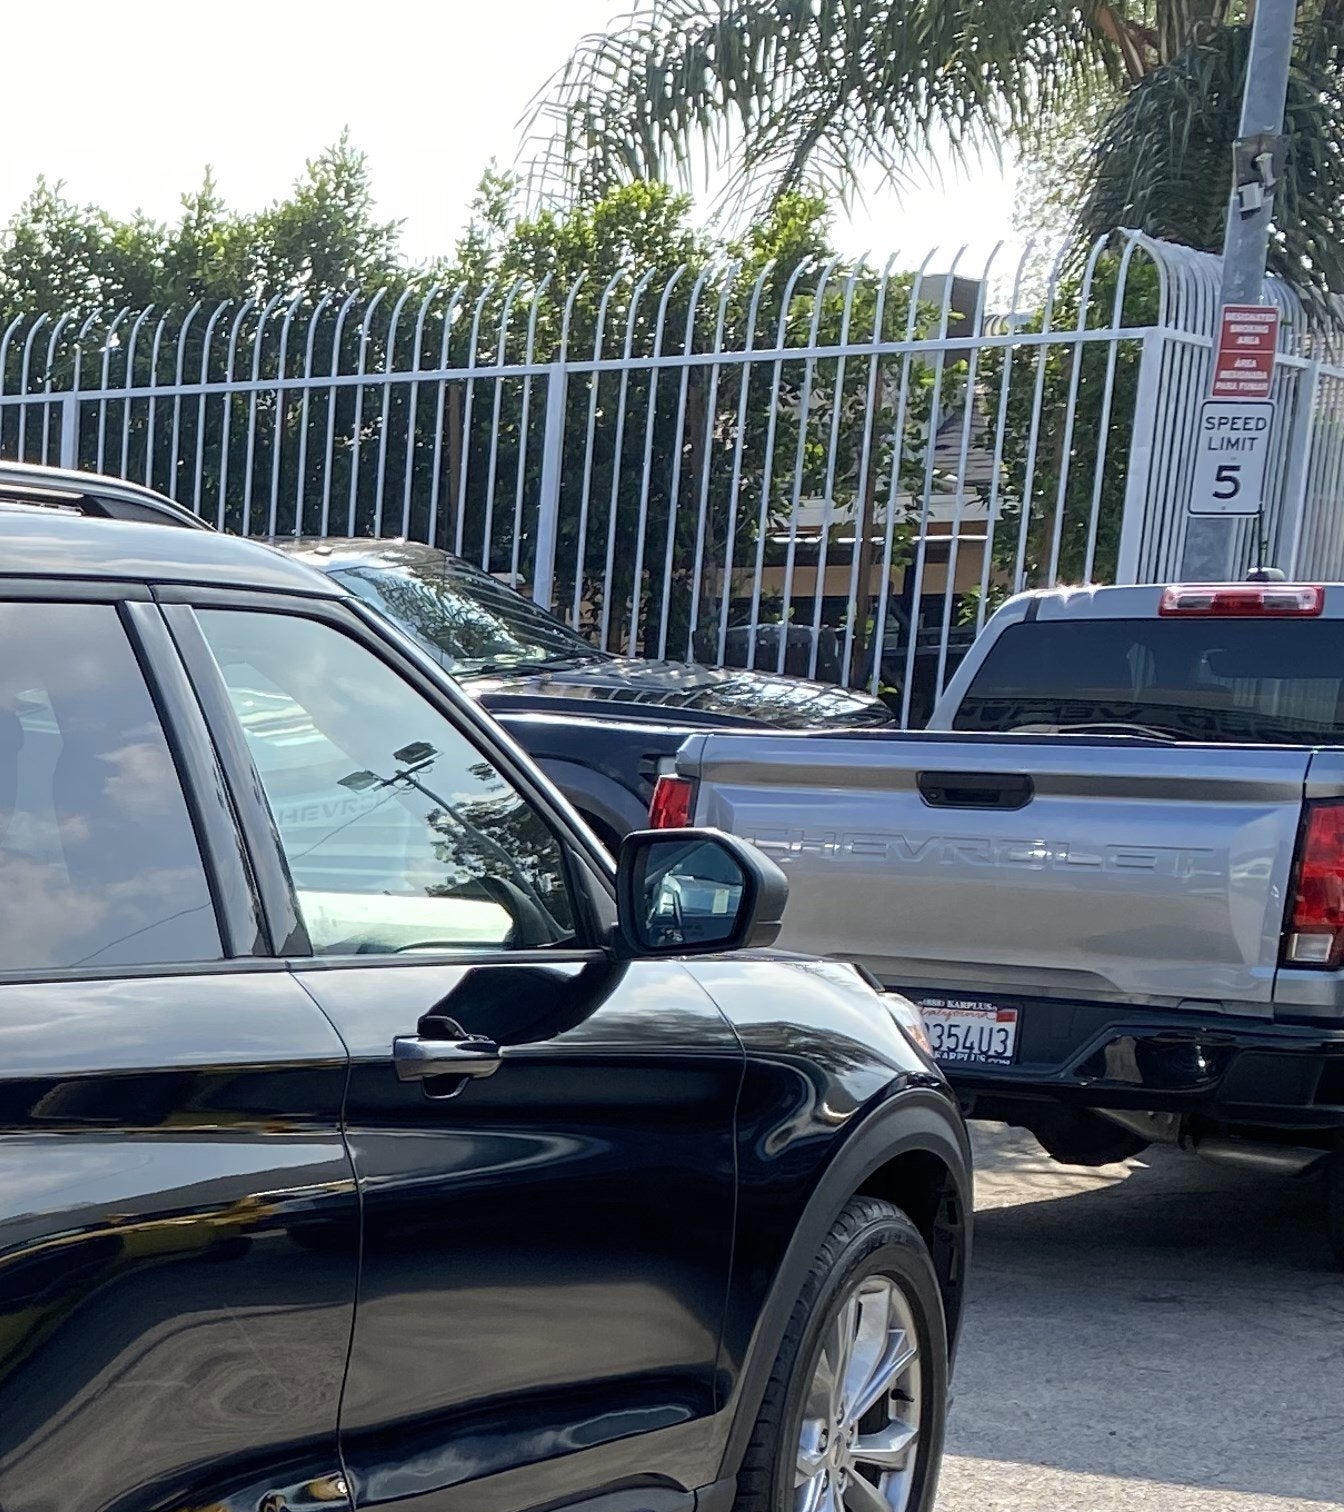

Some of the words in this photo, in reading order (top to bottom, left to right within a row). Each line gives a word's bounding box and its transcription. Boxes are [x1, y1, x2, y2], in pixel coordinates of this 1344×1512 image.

[1204, 416, 1267, 431] SPEED
[1207, 436, 1259, 451] LIMIT
[1212, 464, 1241, 499] 5
